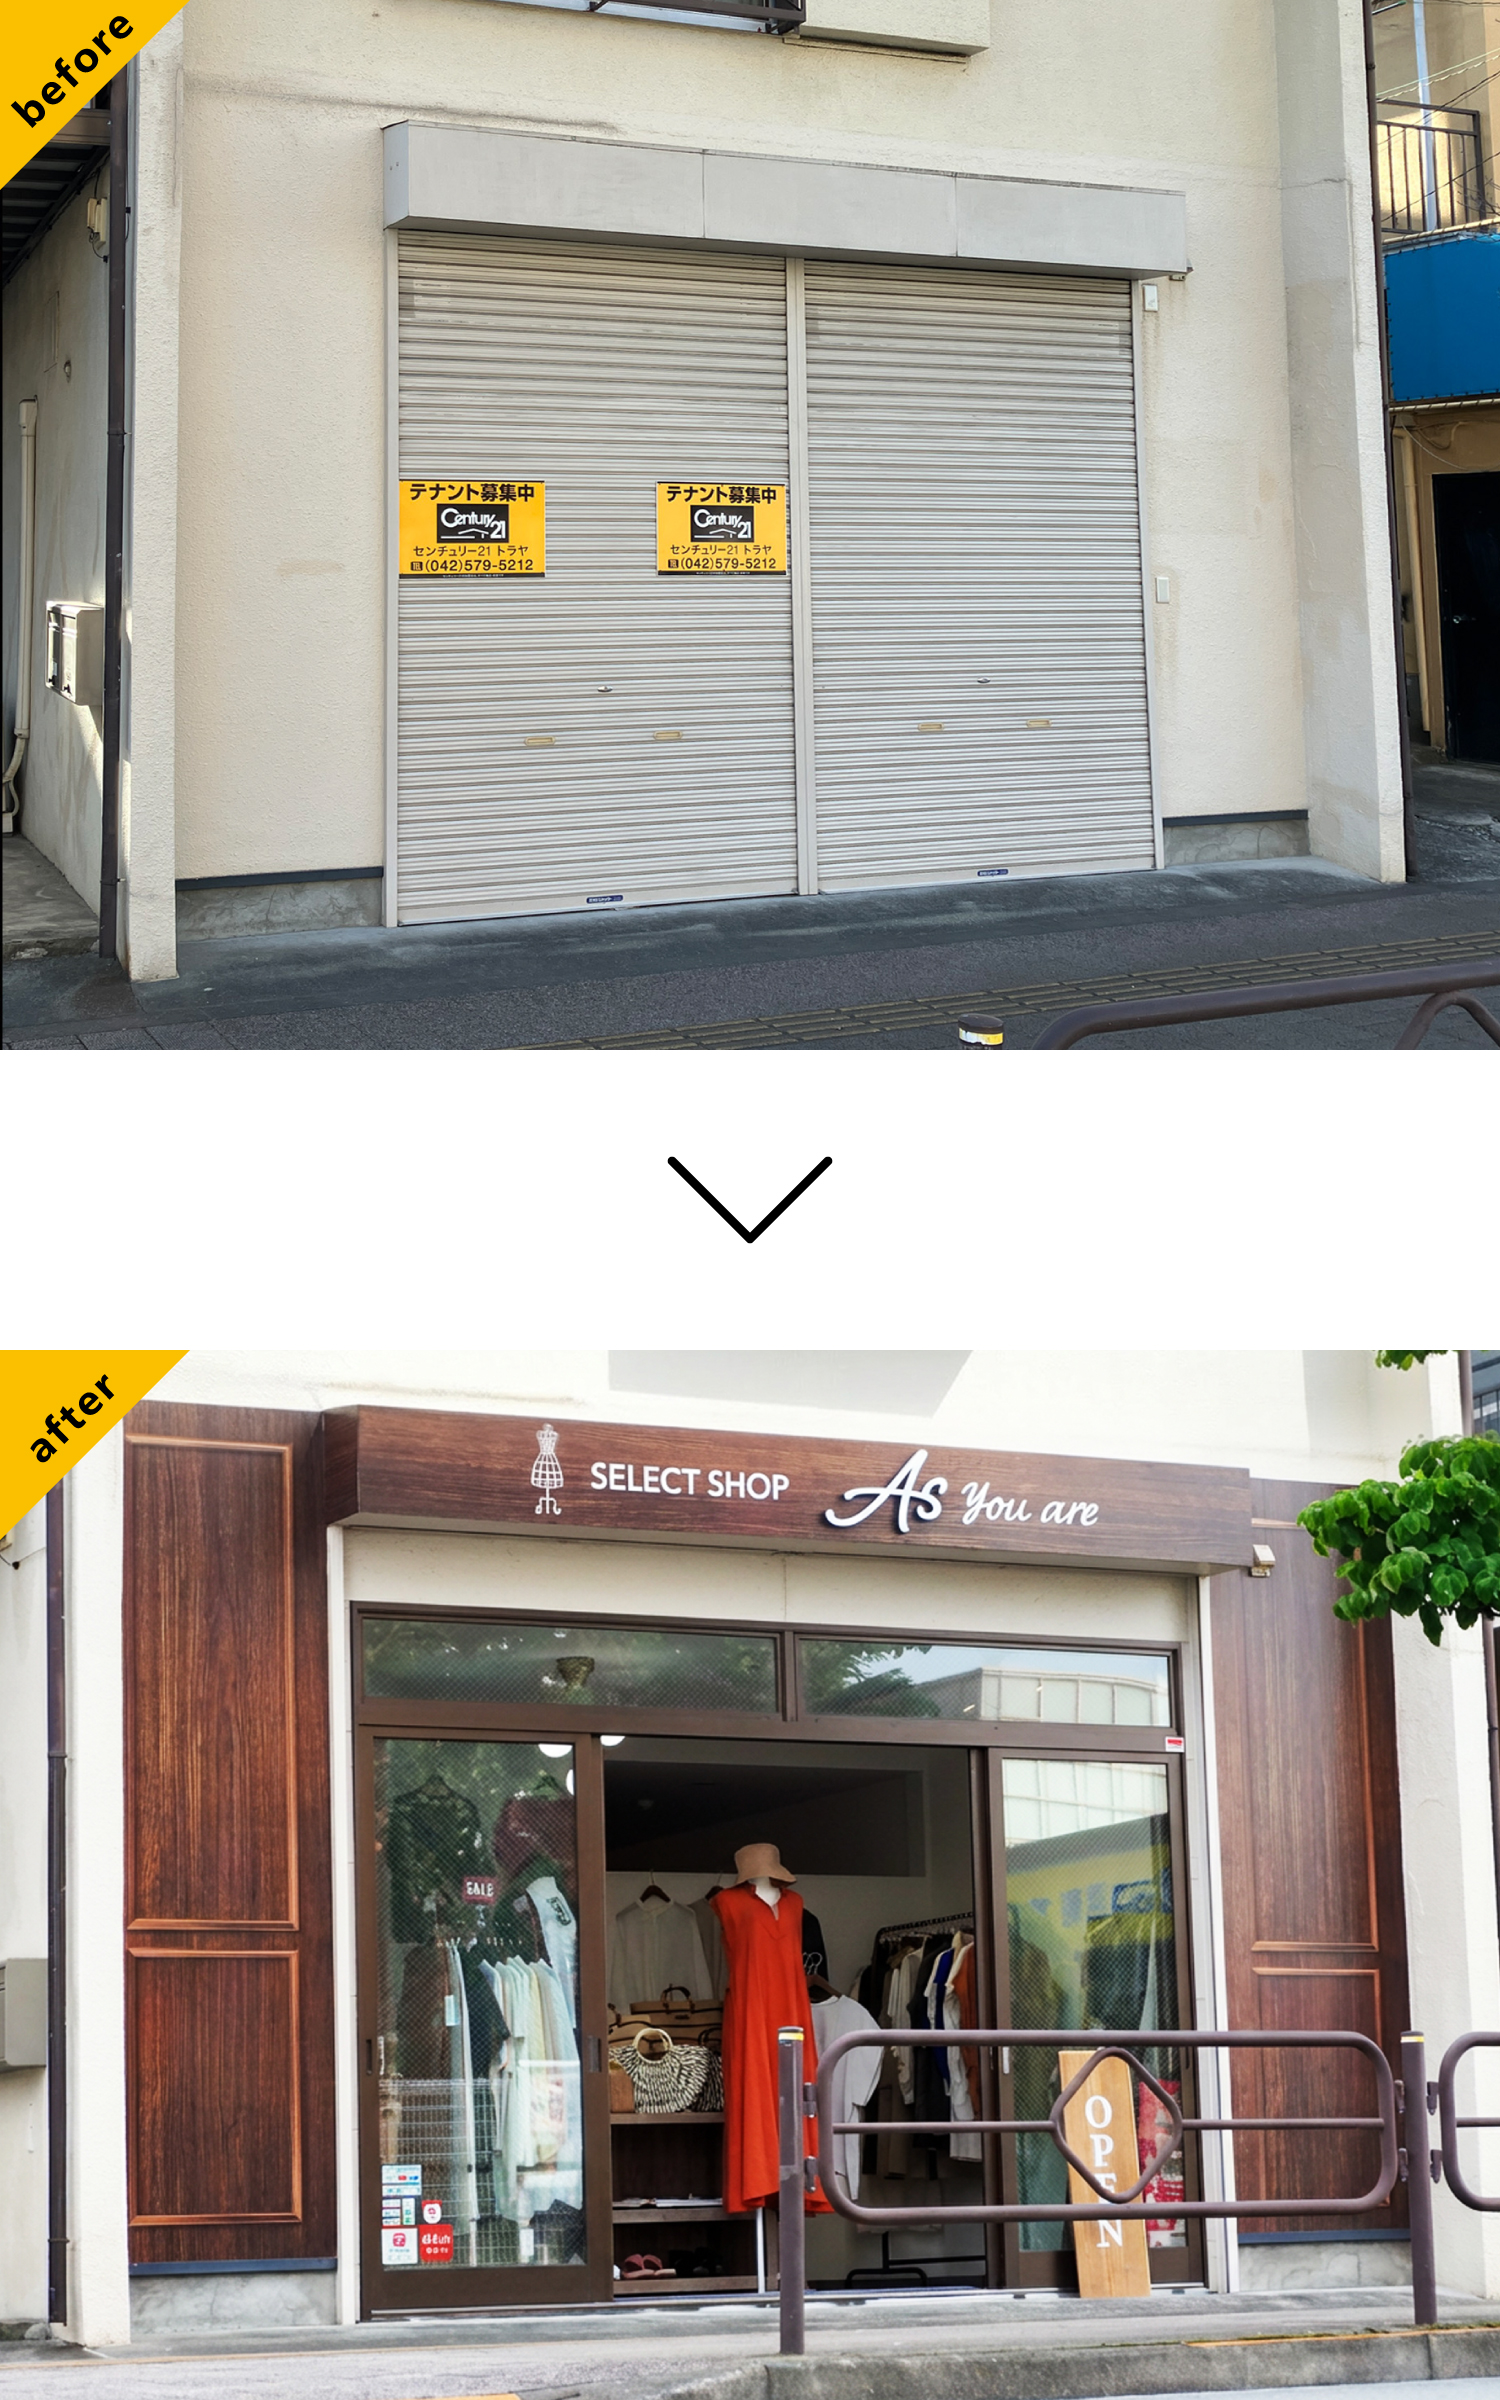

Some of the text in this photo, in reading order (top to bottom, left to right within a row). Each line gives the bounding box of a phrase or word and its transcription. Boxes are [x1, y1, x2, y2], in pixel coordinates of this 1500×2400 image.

[410, 483, 535, 502] テナント募集中
[667, 486, 777, 504] テナント募集中
[441, 508, 506, 539] Century 21
[694, 509, 752, 538] Century 21
[413, 545, 529, 557] センチュリー21 トラヤ
[670, 544, 772, 555] センチュリー21 トラヤ
[425, 559, 534, 572] (042)579-5212
[681, 557, 777, 569] (042)579-5212
[590, 1461, 790, 1500] SELECT SHOP
[824, 1449, 1099, 1534] As You are
